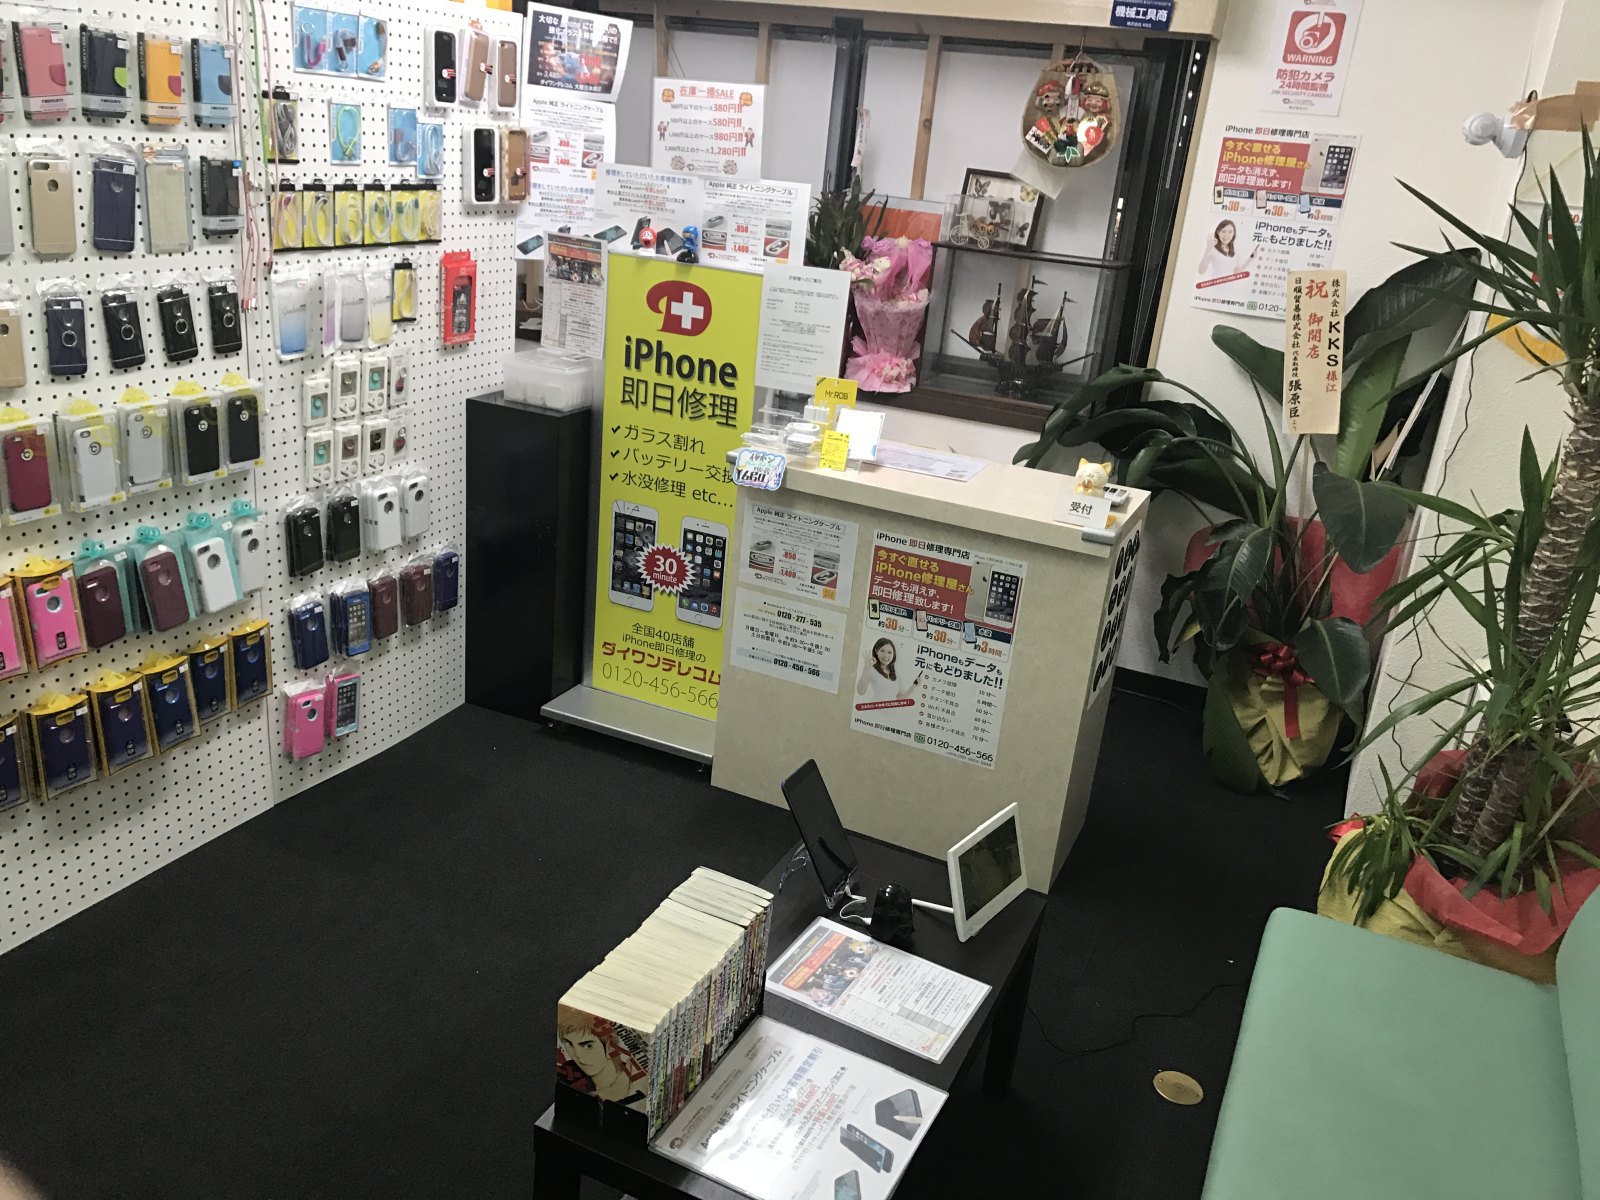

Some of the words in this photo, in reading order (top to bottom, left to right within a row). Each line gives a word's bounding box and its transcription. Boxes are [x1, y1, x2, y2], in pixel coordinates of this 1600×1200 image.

[1115, 5, 1168, 21] 機械工具商
[1287, 54, 1333, 64] WARNING
[1276, 68, 1335, 82] 防犯カメラ
[1279, 80, 1329, 92] 24時間監視
[680, 86, 734, 98] 在庫一掃SALE
[1225, 125, 1253, 134] iPhone
[1255, 127, 1310, 138] 即日修理専門店
[1225, 140, 1281, 154] 今すぐ直せる
[1223, 151, 1312, 170] iPhone修理屋さん
[739, 184, 792, 196] ライトニングケーブル
[1255, 221, 1332, 238] iPhoneもデータも
[1252, 233, 1332, 251] 元にもどりました!!
[1305, 279, 1328, 299] 祝
[1306, 312, 1323, 359] 御開店
[624, 335, 738, 387] iPhone
[620, 376, 737, 428] 即日修理
[624, 424, 706, 455] ガラス割れ
[623, 448, 738, 484] バッテリー交換
[622, 470, 686, 498] 水没修理
[757, 507, 773, 516] Apple
[774, 510, 785, 518] 純正
[787, 513, 841, 531] ライトニングケーブル
[1070, 502, 1093, 515] 受付
[876, 532, 907, 546] iPhone
[909, 539, 970, 560] 即日修理専門店
[653, 555, 677, 574] 30
[877, 550, 939, 572] 今すぐ直せる
[653, 572, 677, 584] minute
[875, 562, 975, 595] iPhone修理屋さん
[872, 586, 954, 614] 即日修理致します!
[632, 622, 695, 649] 全国40店舗
[622, 634, 706, 663] iPhone即日修理の
[917, 645, 1003, 676] iPhoneもデータも
[914, 657, 1003, 689] 元にもどりました!!
[602, 662, 719, 709] 0120-456-566
[854, 718, 874, 728] iPhone
[927, 737, 993, 762] 0120-456-566
[720, 1111, 734, 1128] 純正
[732, 1048, 783, 1112] ライトニングケーブル
